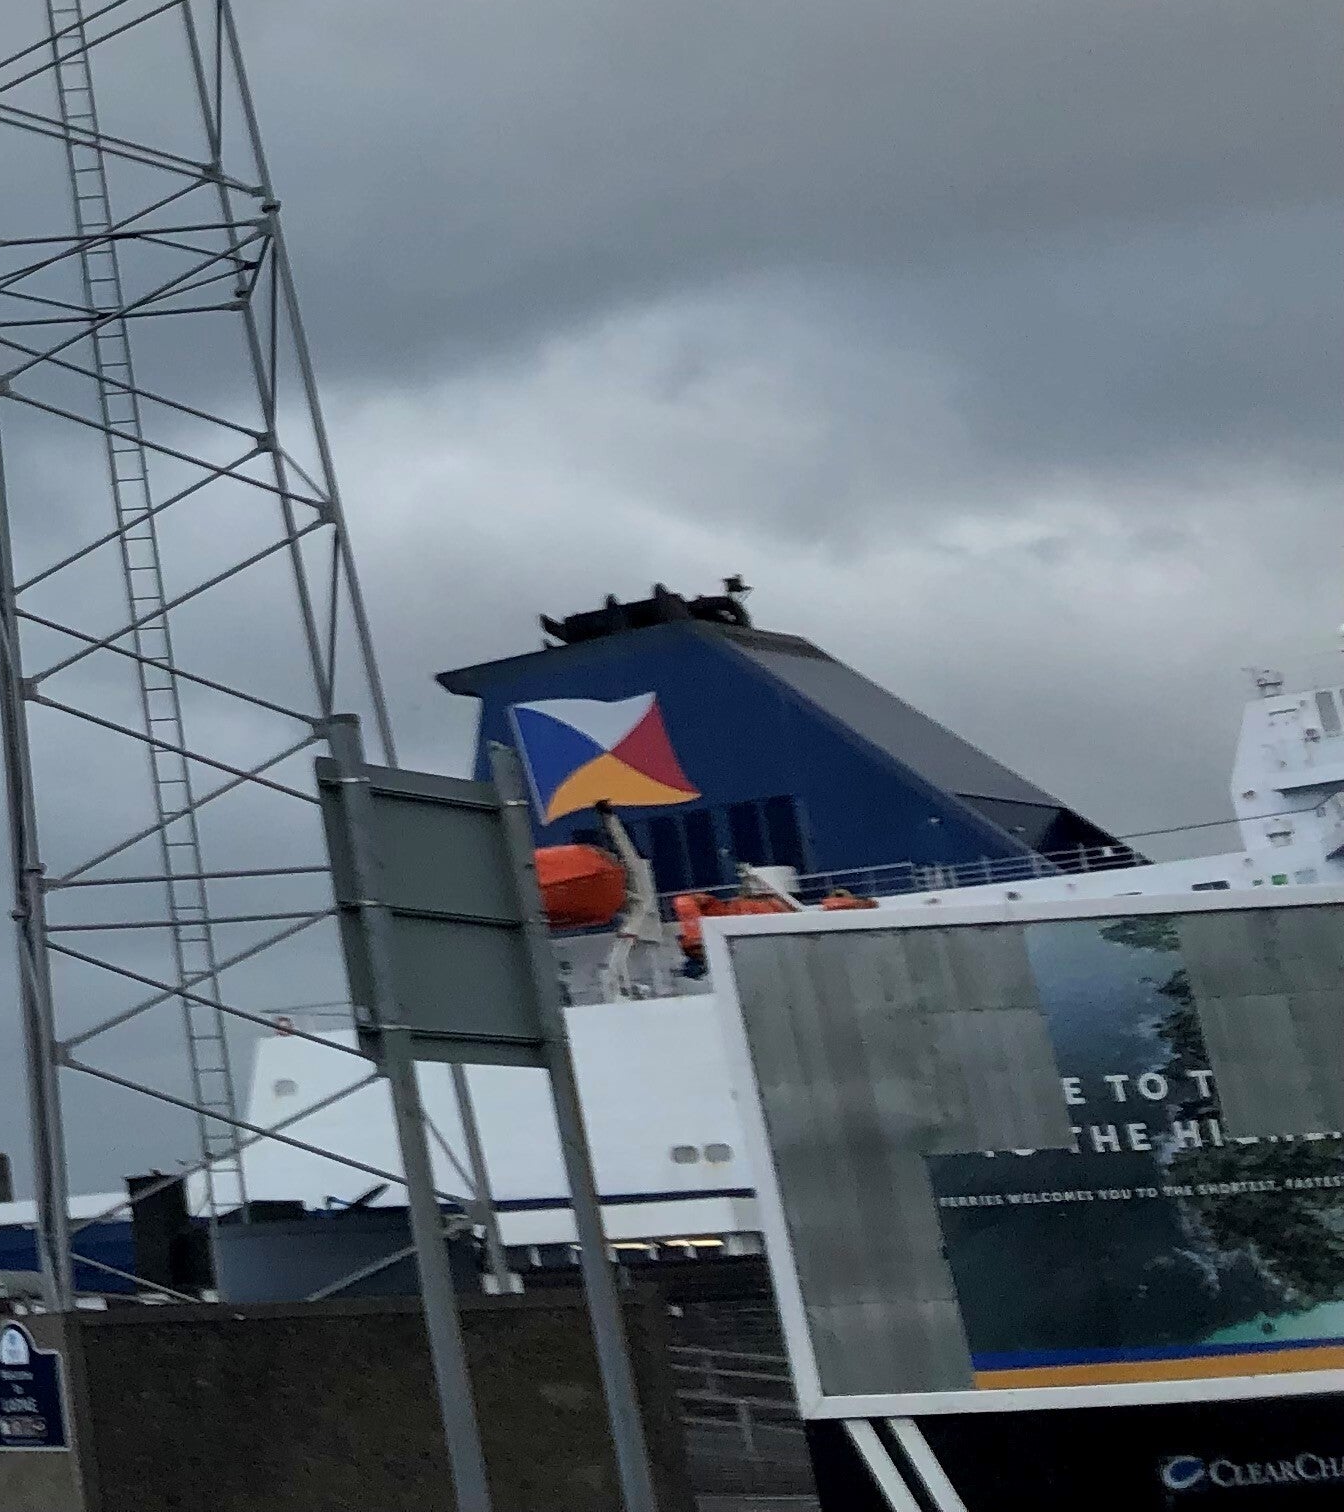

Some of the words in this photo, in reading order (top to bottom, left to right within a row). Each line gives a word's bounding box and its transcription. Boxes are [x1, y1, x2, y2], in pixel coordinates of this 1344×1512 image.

[1104, 1072, 1168, 1103] TO
[1006, 1190, 1093, 1204] WELCOMES
[1097, 1188, 1132, 1201] YOU
[1136, 1187, 1158, 1198] TO
[1162, 1185, 1193, 1197] THE
[1209, 1451, 1344, 1488] CLEARCH
